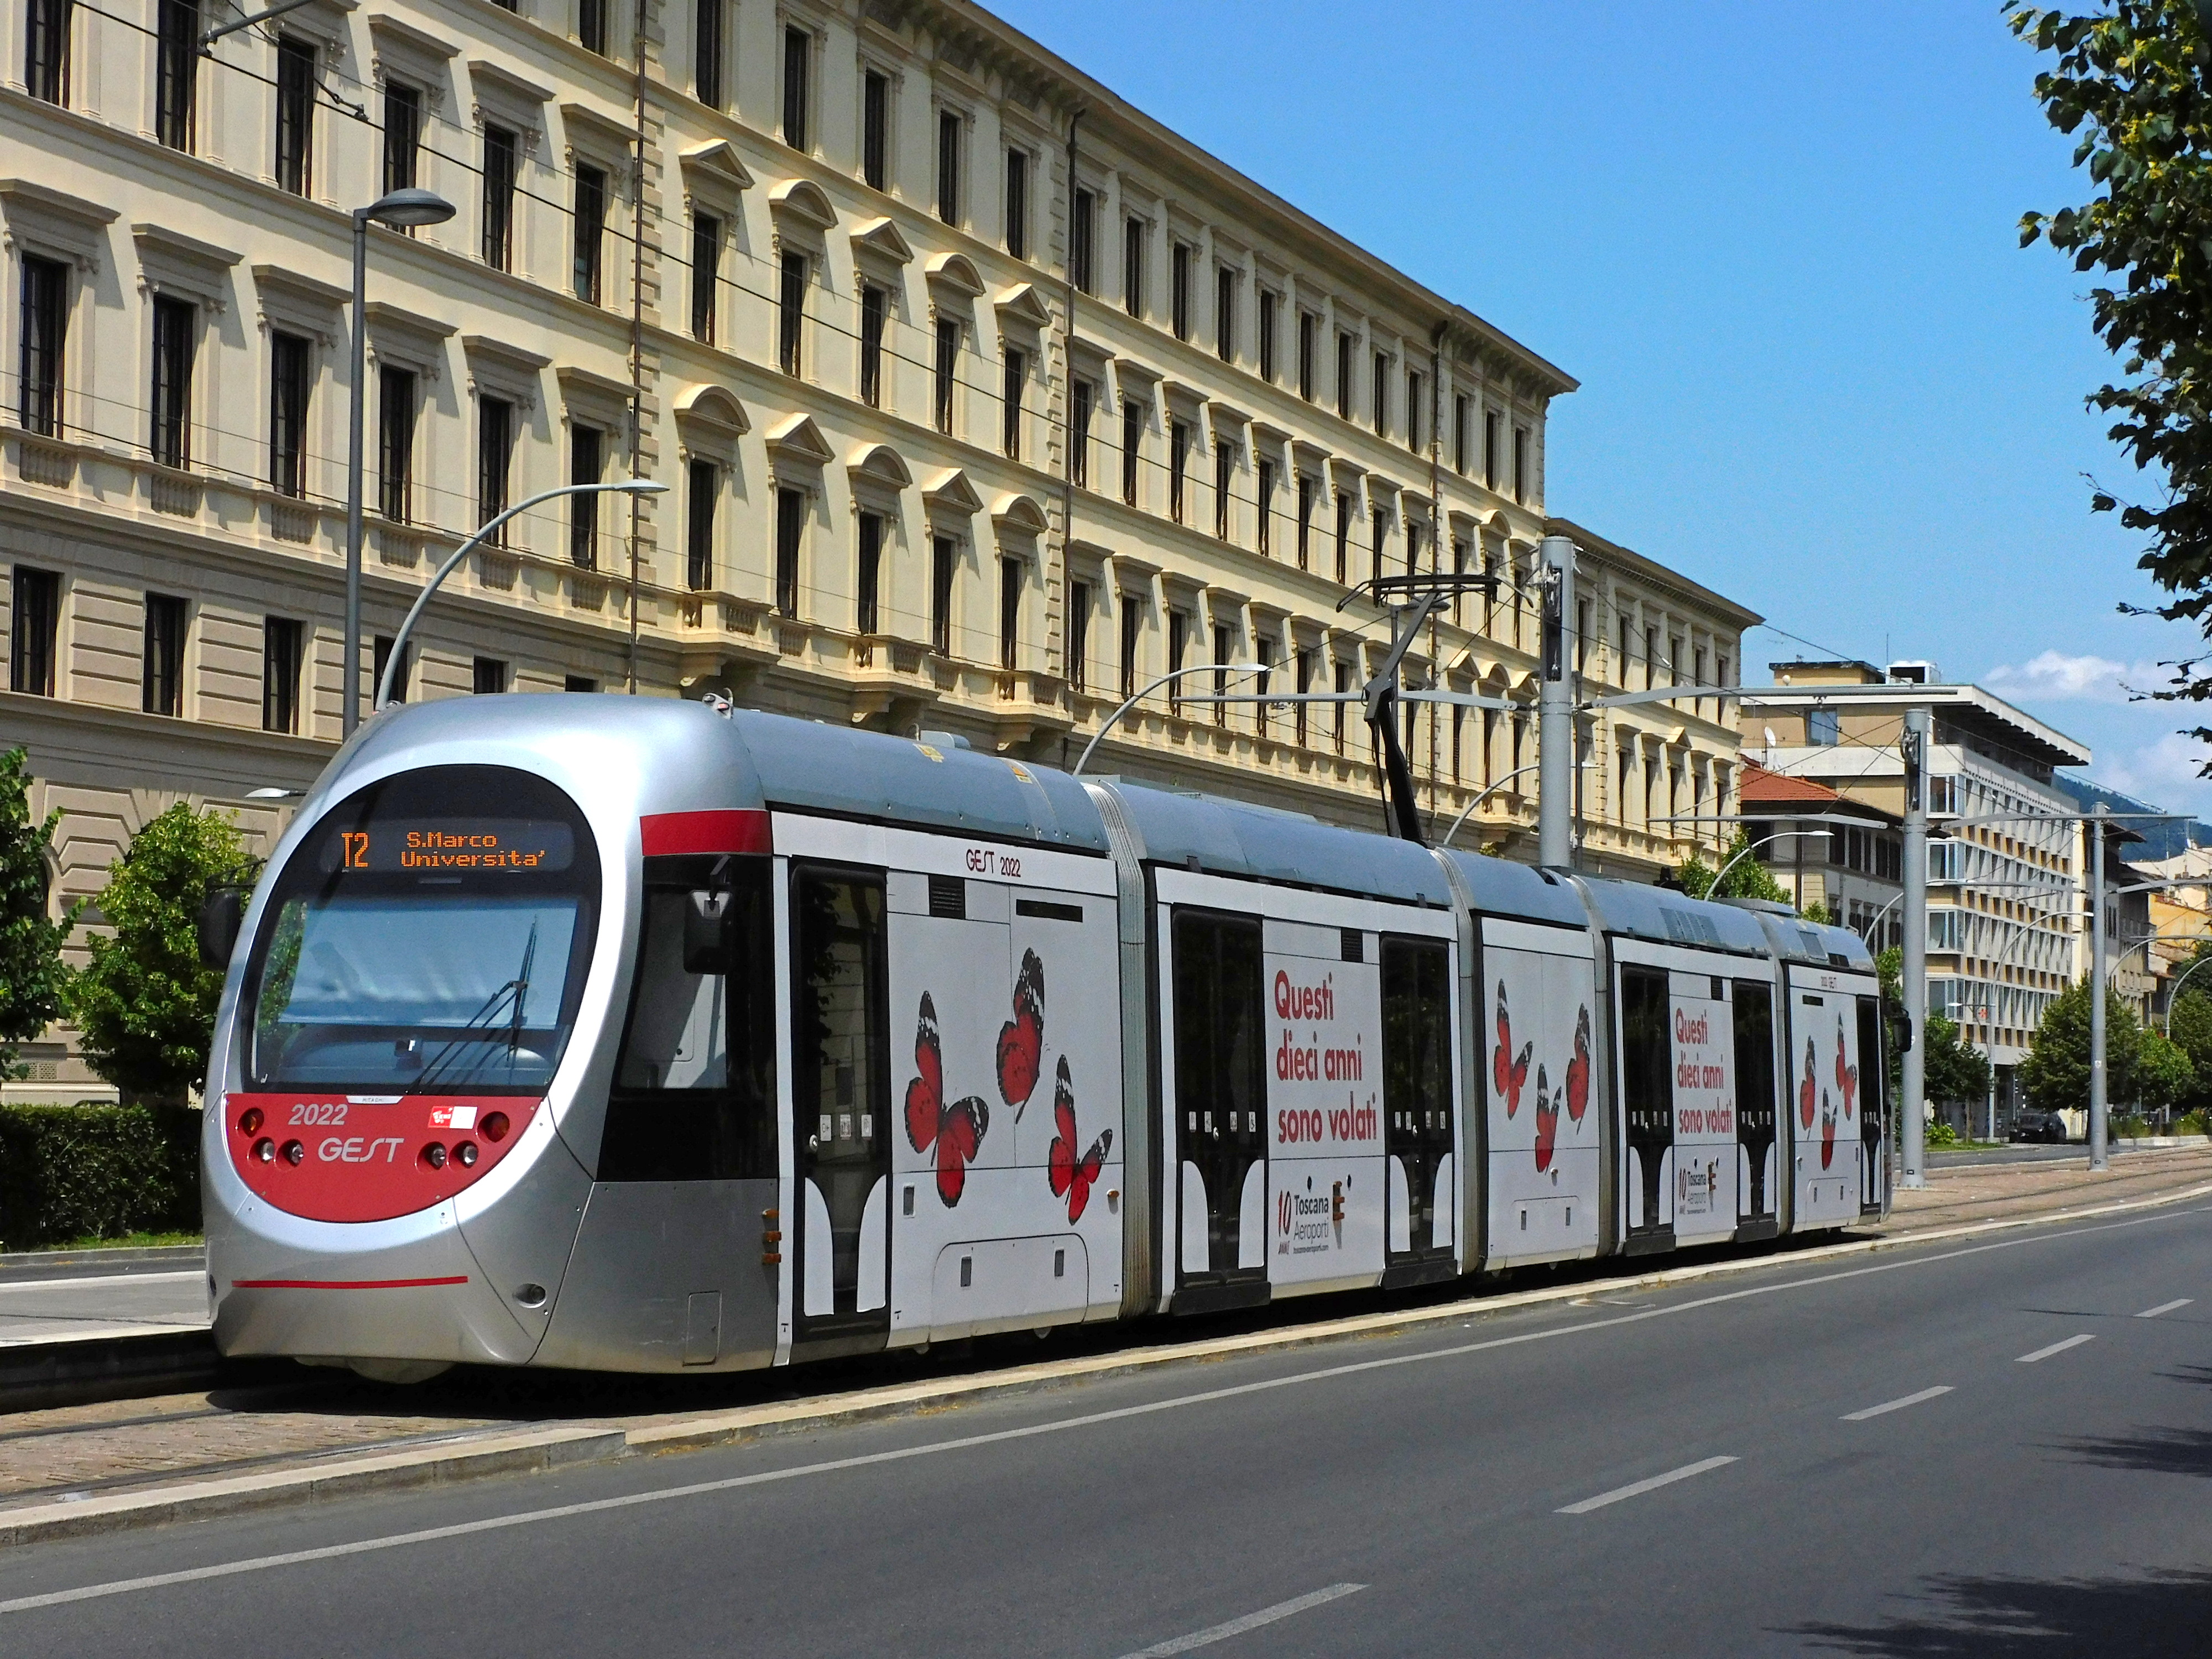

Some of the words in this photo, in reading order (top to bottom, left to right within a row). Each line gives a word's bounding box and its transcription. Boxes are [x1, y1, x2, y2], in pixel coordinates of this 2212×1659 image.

[341, 832, 369, 868] T2
[406, 832, 497, 848] S.Marco
[966, 849, 994, 874] GEST
[1000, 857, 1021, 878] 2022
[1275, 969, 1334, 1021] Questi
[1676, 1008, 1708, 1045] Questi
[1276, 1029, 1318, 1081] dieci
[1324, 1032, 1362, 1081] anni
[1677, 1050, 1700, 1089] dieci
[1703, 1054, 1724, 1089] anni
[288, 1103, 348, 1126] 2022
[1278, 1109, 1323, 1144] sono
[1327, 1091, 1377, 1142] volati
[1679, 1109, 1703, 1134] sono
[1704, 1097, 1733, 1134] volati
[318, 1137, 404, 1162] GEST
[1679, 1167, 1687, 1202] 10
[1278, 1190, 1292, 1237] 10
[1294, 1194, 1329, 1215] Toscana
[1293, 1216, 1329, 1244] Aeroporti
